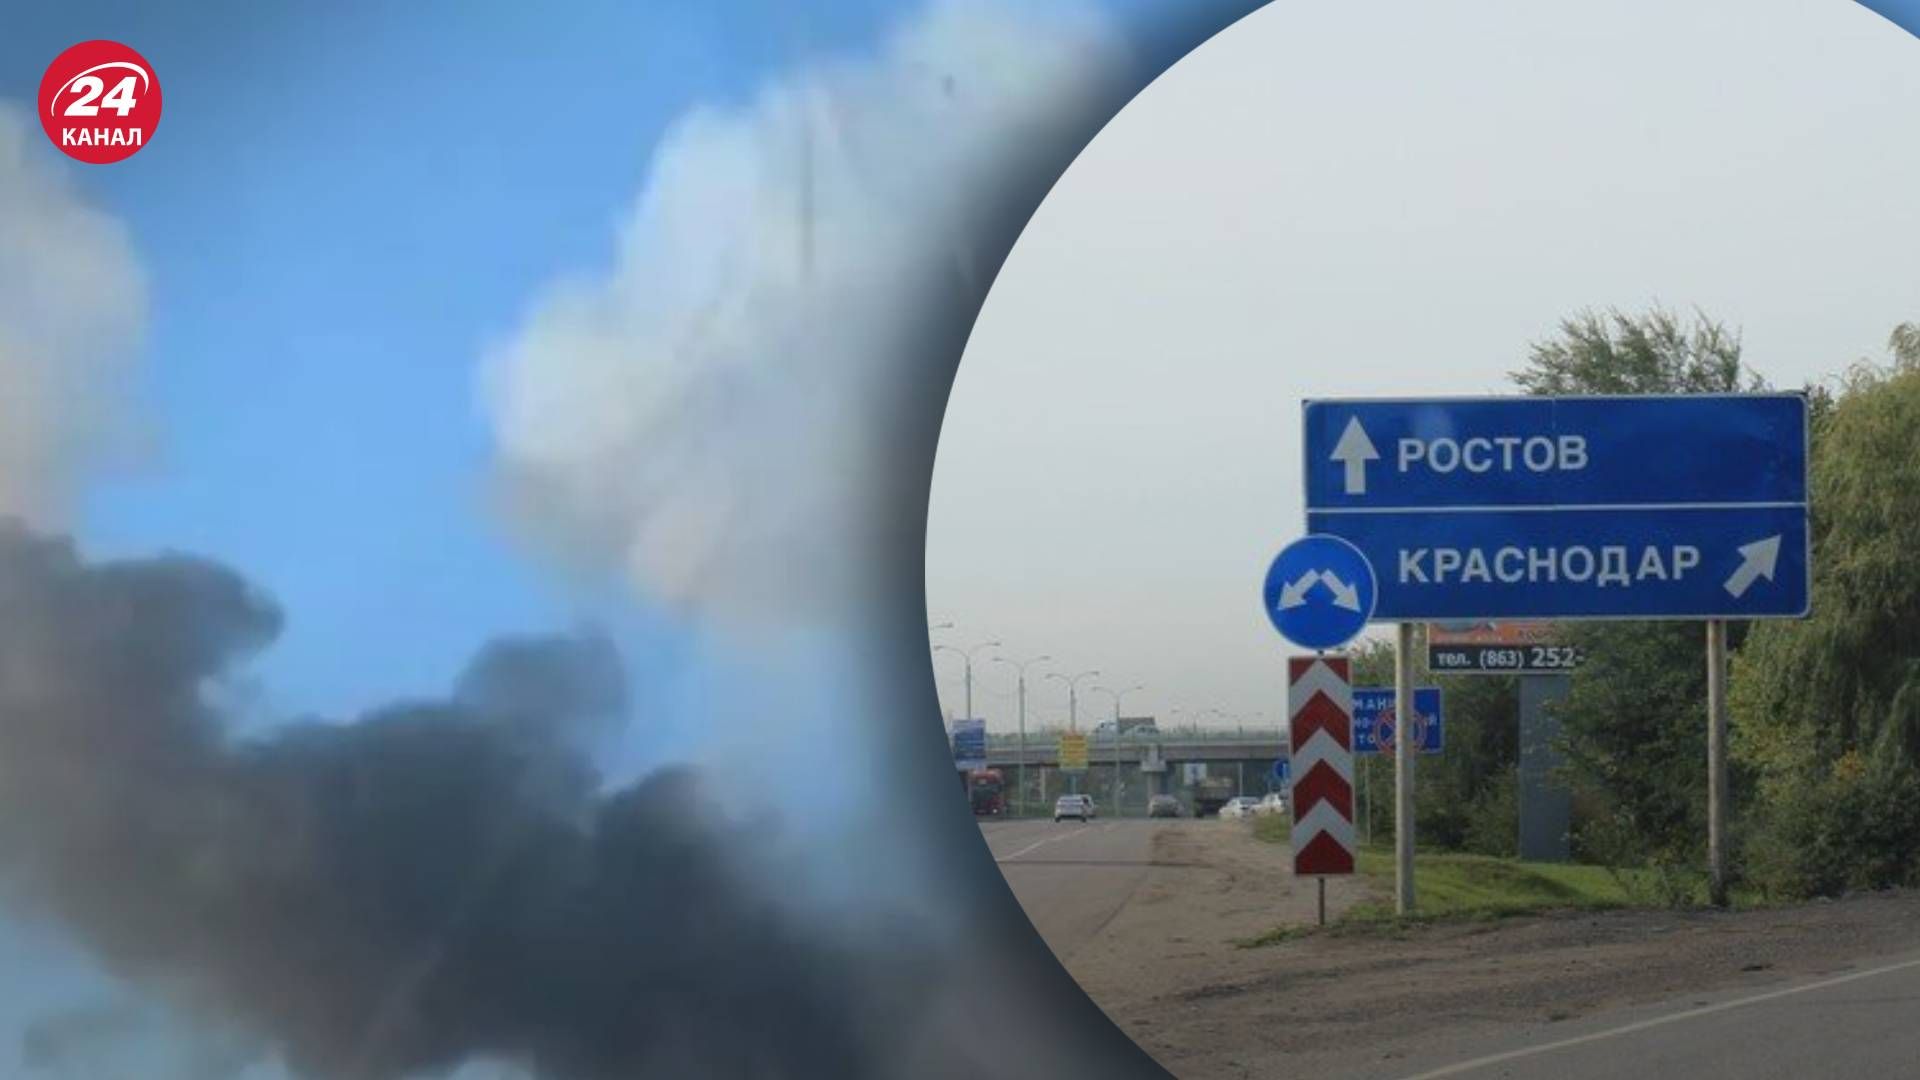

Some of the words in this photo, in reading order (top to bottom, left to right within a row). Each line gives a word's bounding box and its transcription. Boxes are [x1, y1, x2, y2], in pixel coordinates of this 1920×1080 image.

[1397, 435, 1588, 472] РОСТОВ
[1399, 545, 1700, 587] КРАСНОДАР
[1479, 649, 1524, 670] (863)
